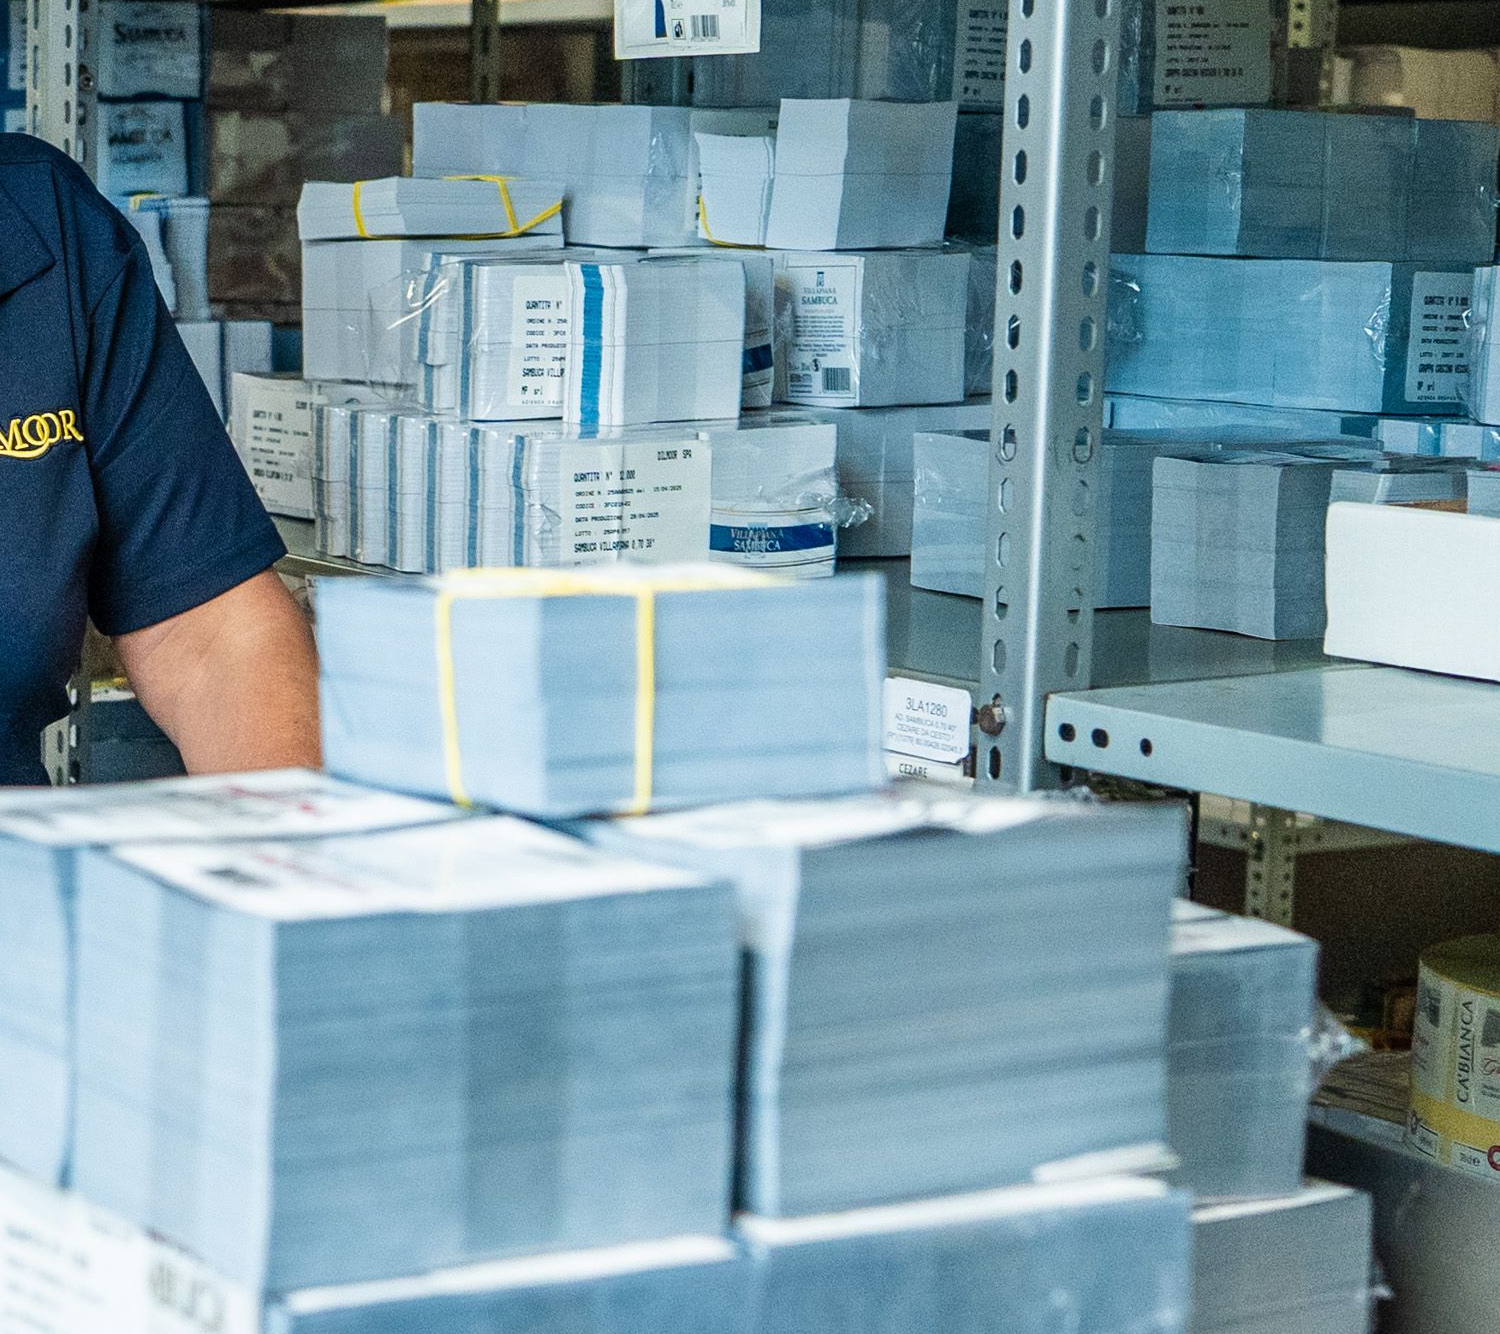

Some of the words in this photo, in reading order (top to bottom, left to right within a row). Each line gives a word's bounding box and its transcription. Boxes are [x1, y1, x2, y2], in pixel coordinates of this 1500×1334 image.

[657, 450, 678, 461] DILMOOR
[573, 542, 597, 553] SAMBUCA
[733, 539, 781, 552] SAMBUCA
[905, 697, 948, 718] 3LA1280
[899, 763, 928, 778] CEZARE
[1458, 1000, 1474, 1104] CA'BIANCA
